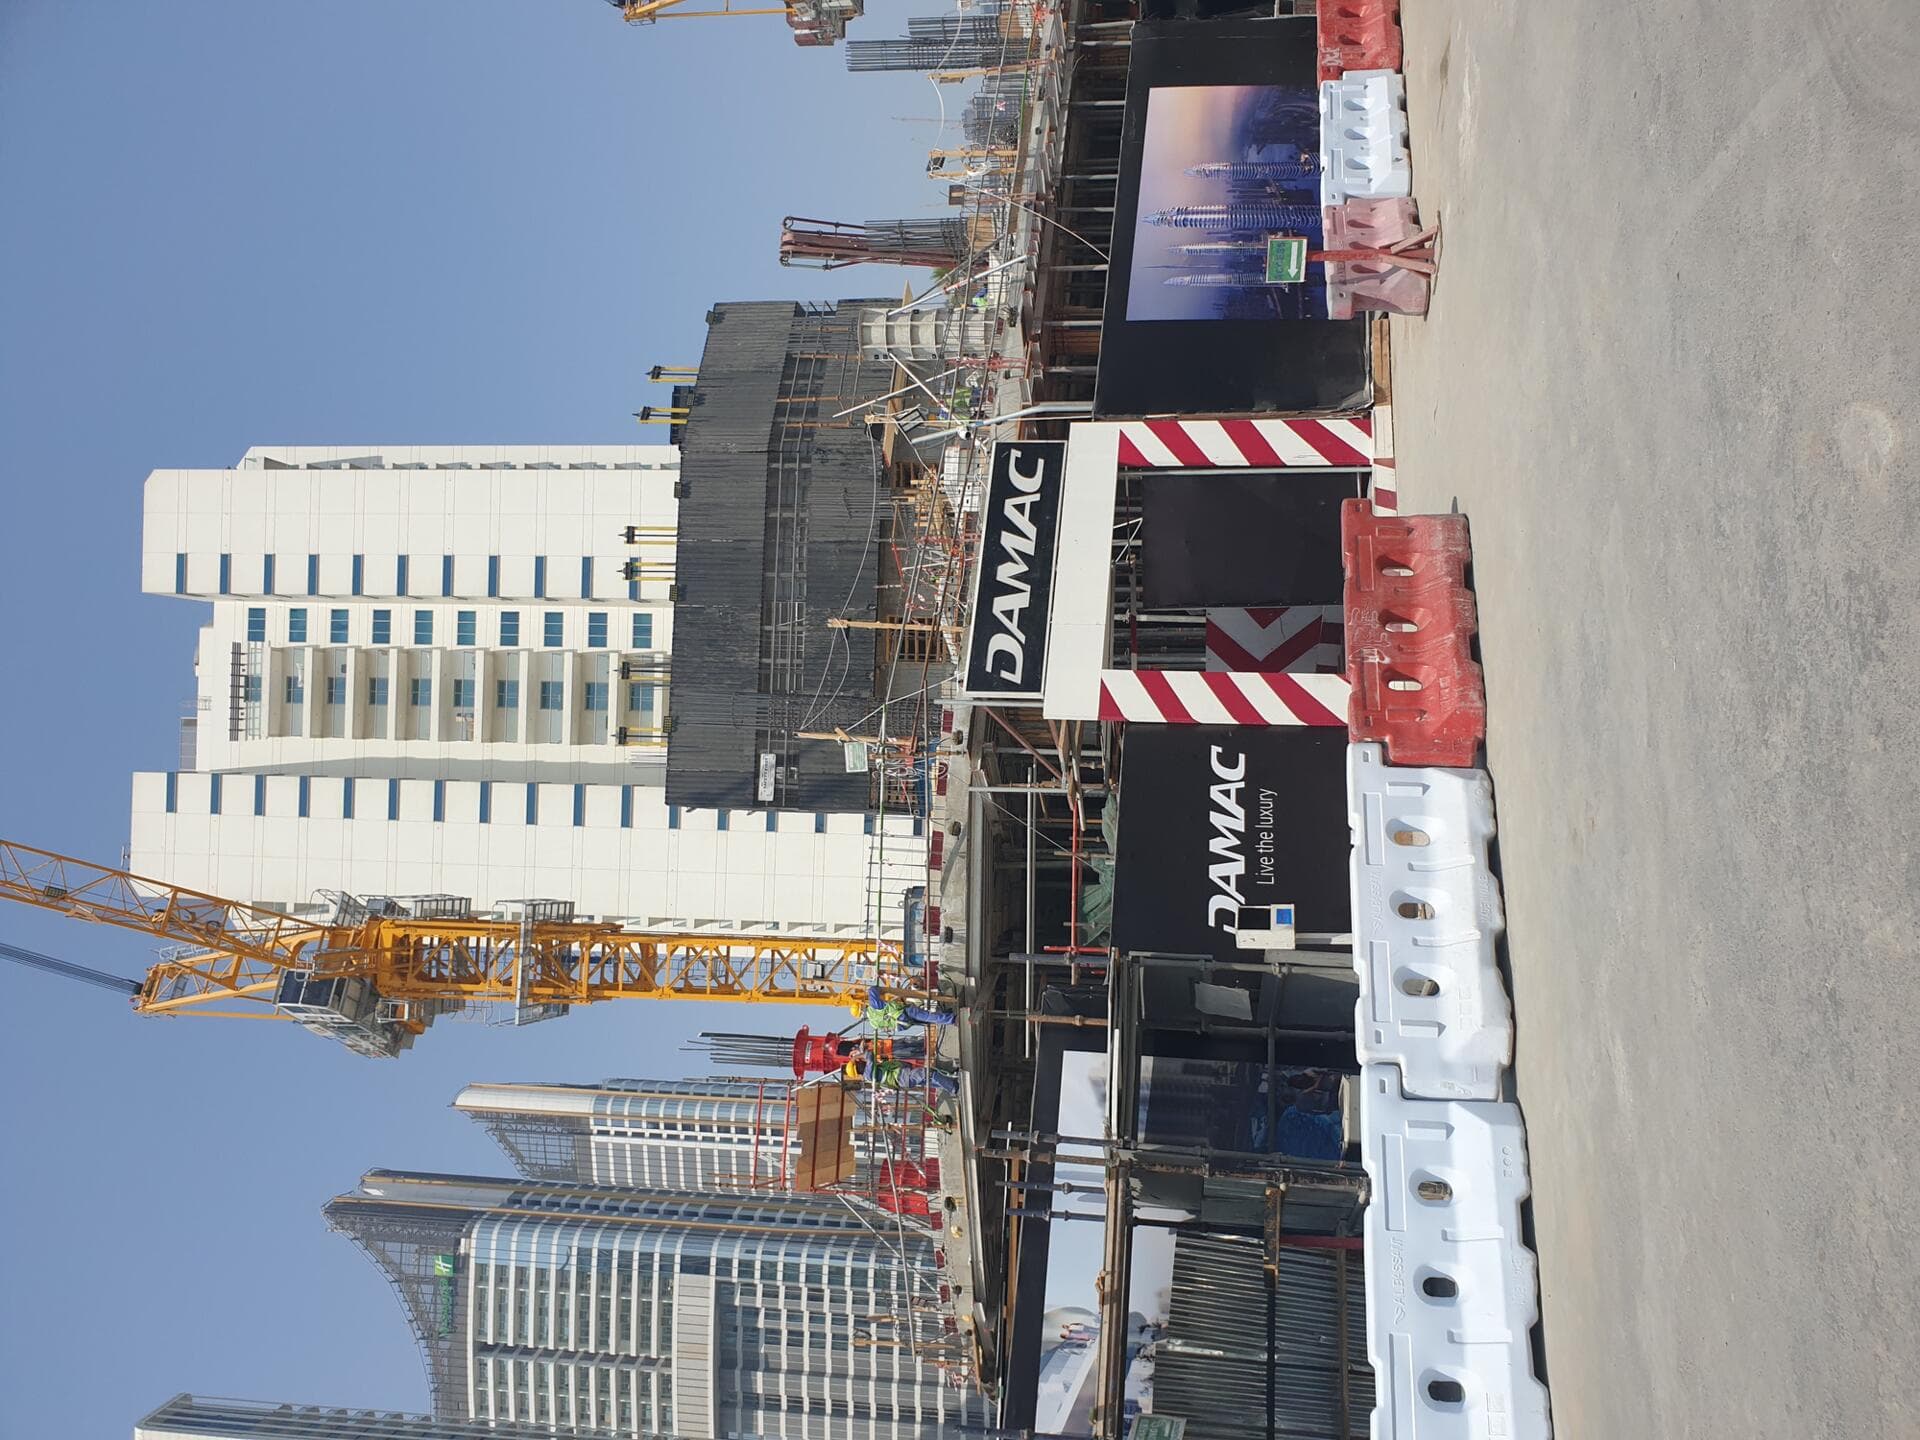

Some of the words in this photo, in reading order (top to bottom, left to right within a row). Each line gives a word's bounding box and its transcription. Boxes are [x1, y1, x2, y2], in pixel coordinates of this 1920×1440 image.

[985, 448, 1045, 685] DAMAC
[1254, 788, 1278, 828] luxury
[1208, 744, 1246, 935] DAMAC
[1254, 831, 1274, 853] the
[1255, 856, 1275, 885] Live
